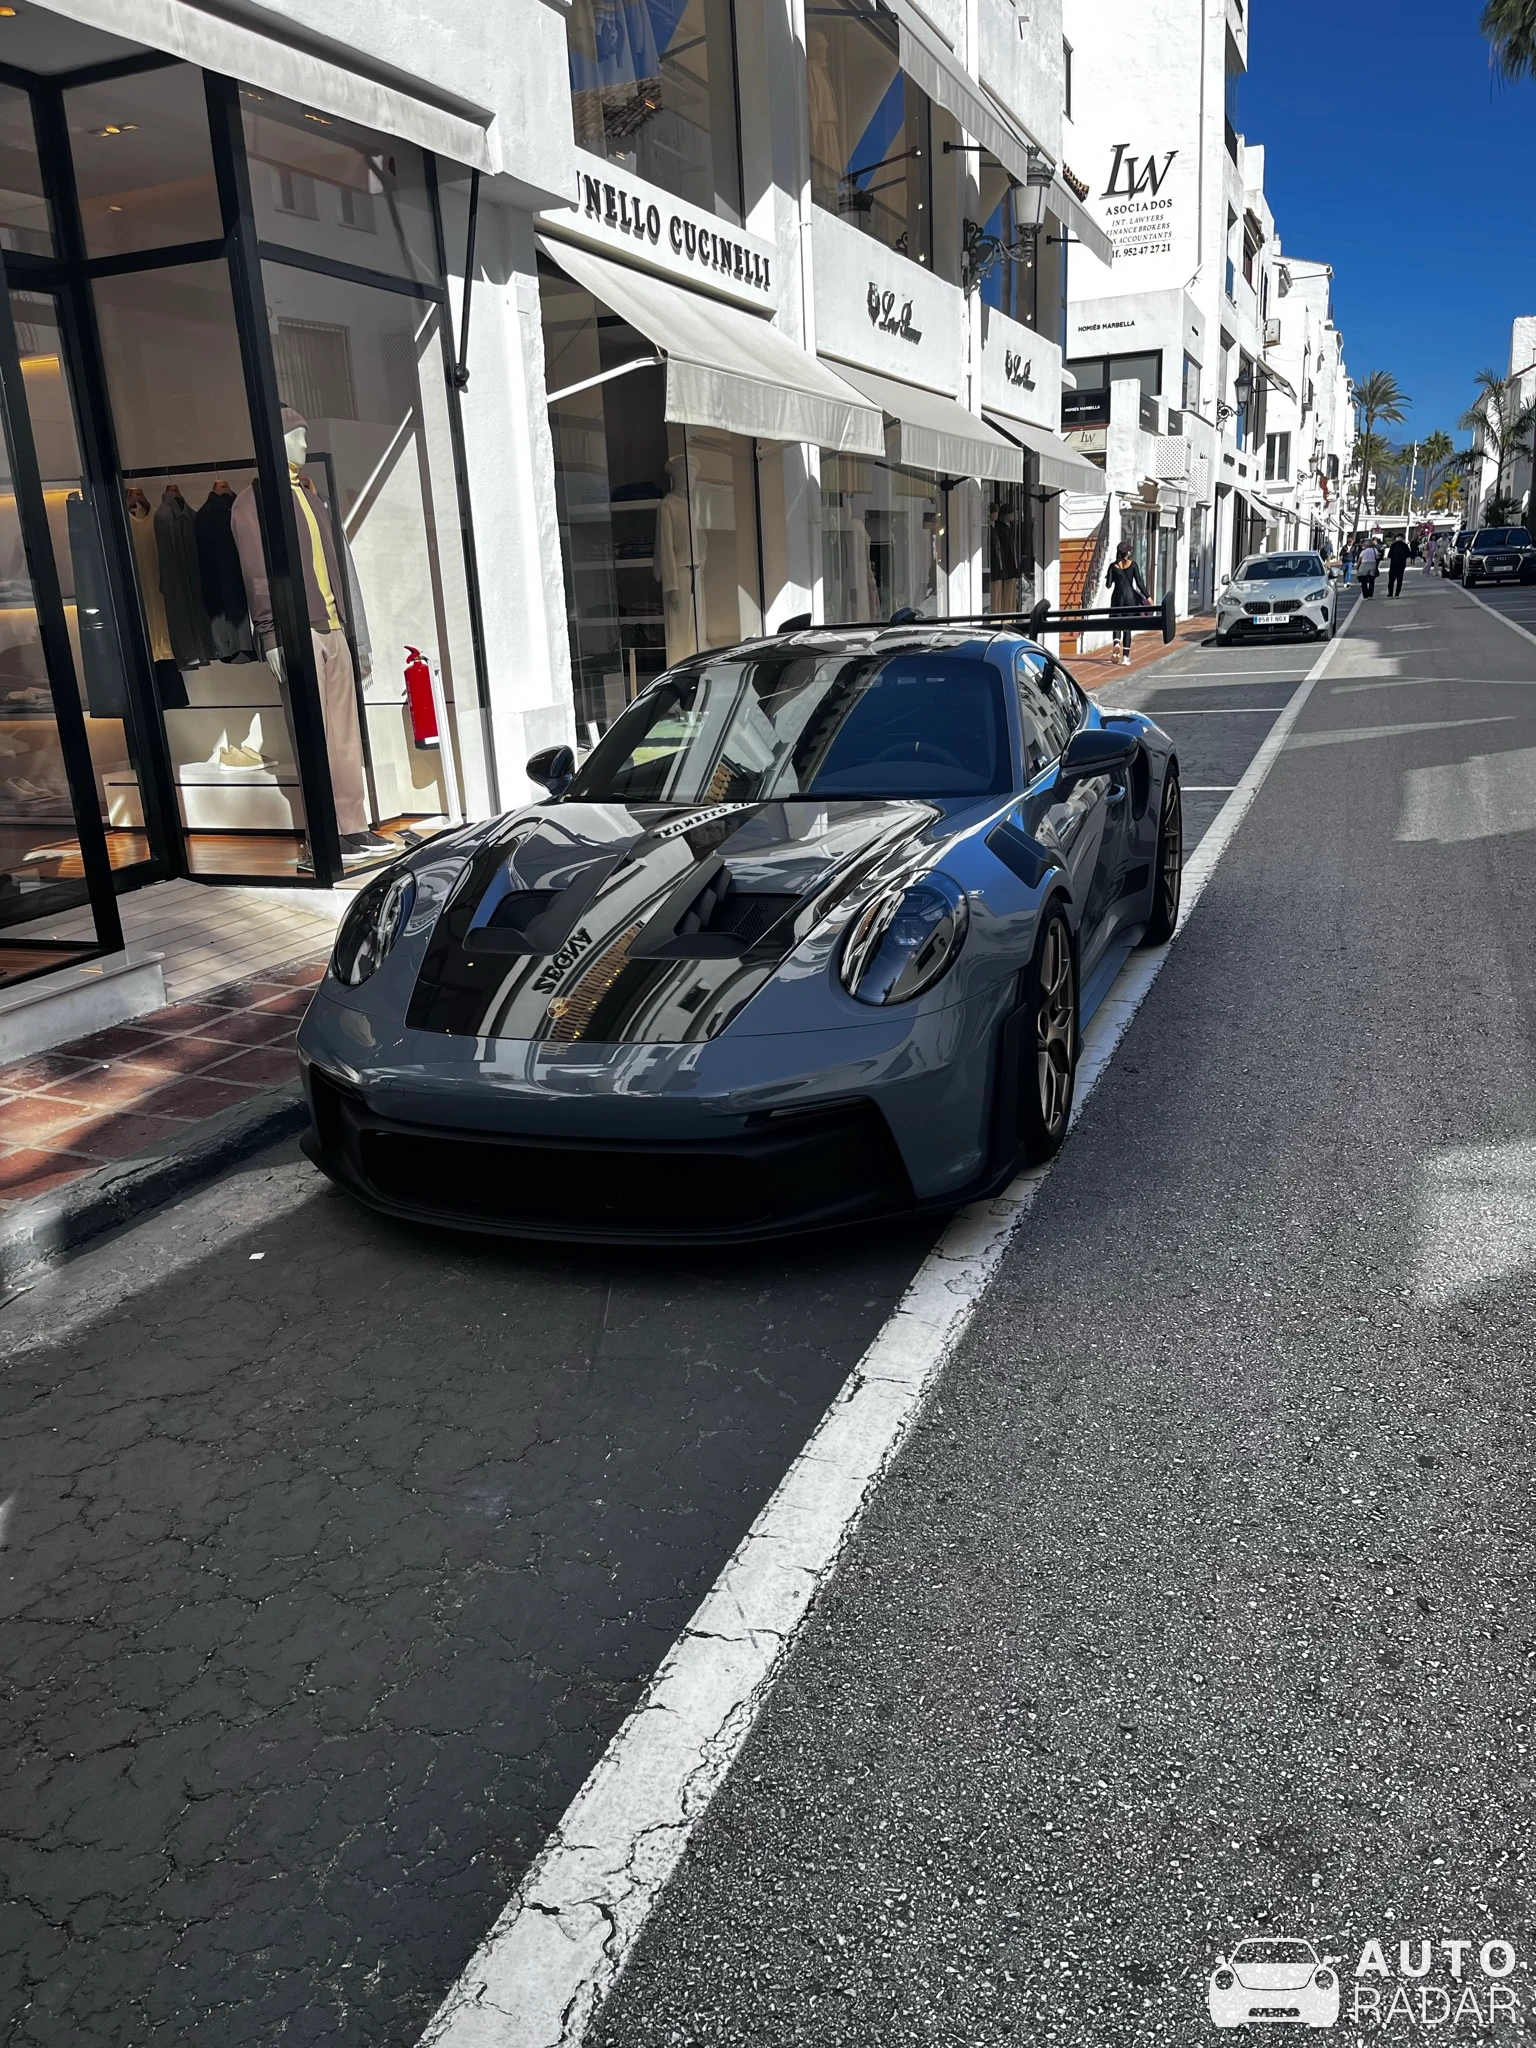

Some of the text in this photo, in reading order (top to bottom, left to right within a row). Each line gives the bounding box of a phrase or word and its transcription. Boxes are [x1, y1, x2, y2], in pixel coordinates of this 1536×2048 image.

[1100, 143, 1178, 200] LW
[1105, 198, 1173, 216] ASOCIADOS
[1130, 214, 1164, 225] LAWYERS
[577, 170, 770, 287] NELLO CUCINELLI
[1106, 222, 1170, 236] FINANCE BROKERS
[1119, 231, 1172, 244] ACCOUNTANTS
[1123, 248, 1137, 257] 952
[1139, 246, 1149, 255] 47
[1150, 244, 1160, 253] 27
[1161, 243, 1171, 252] 21
[1078, 320, 1135, 332] HOMIÉS MARBELLA
